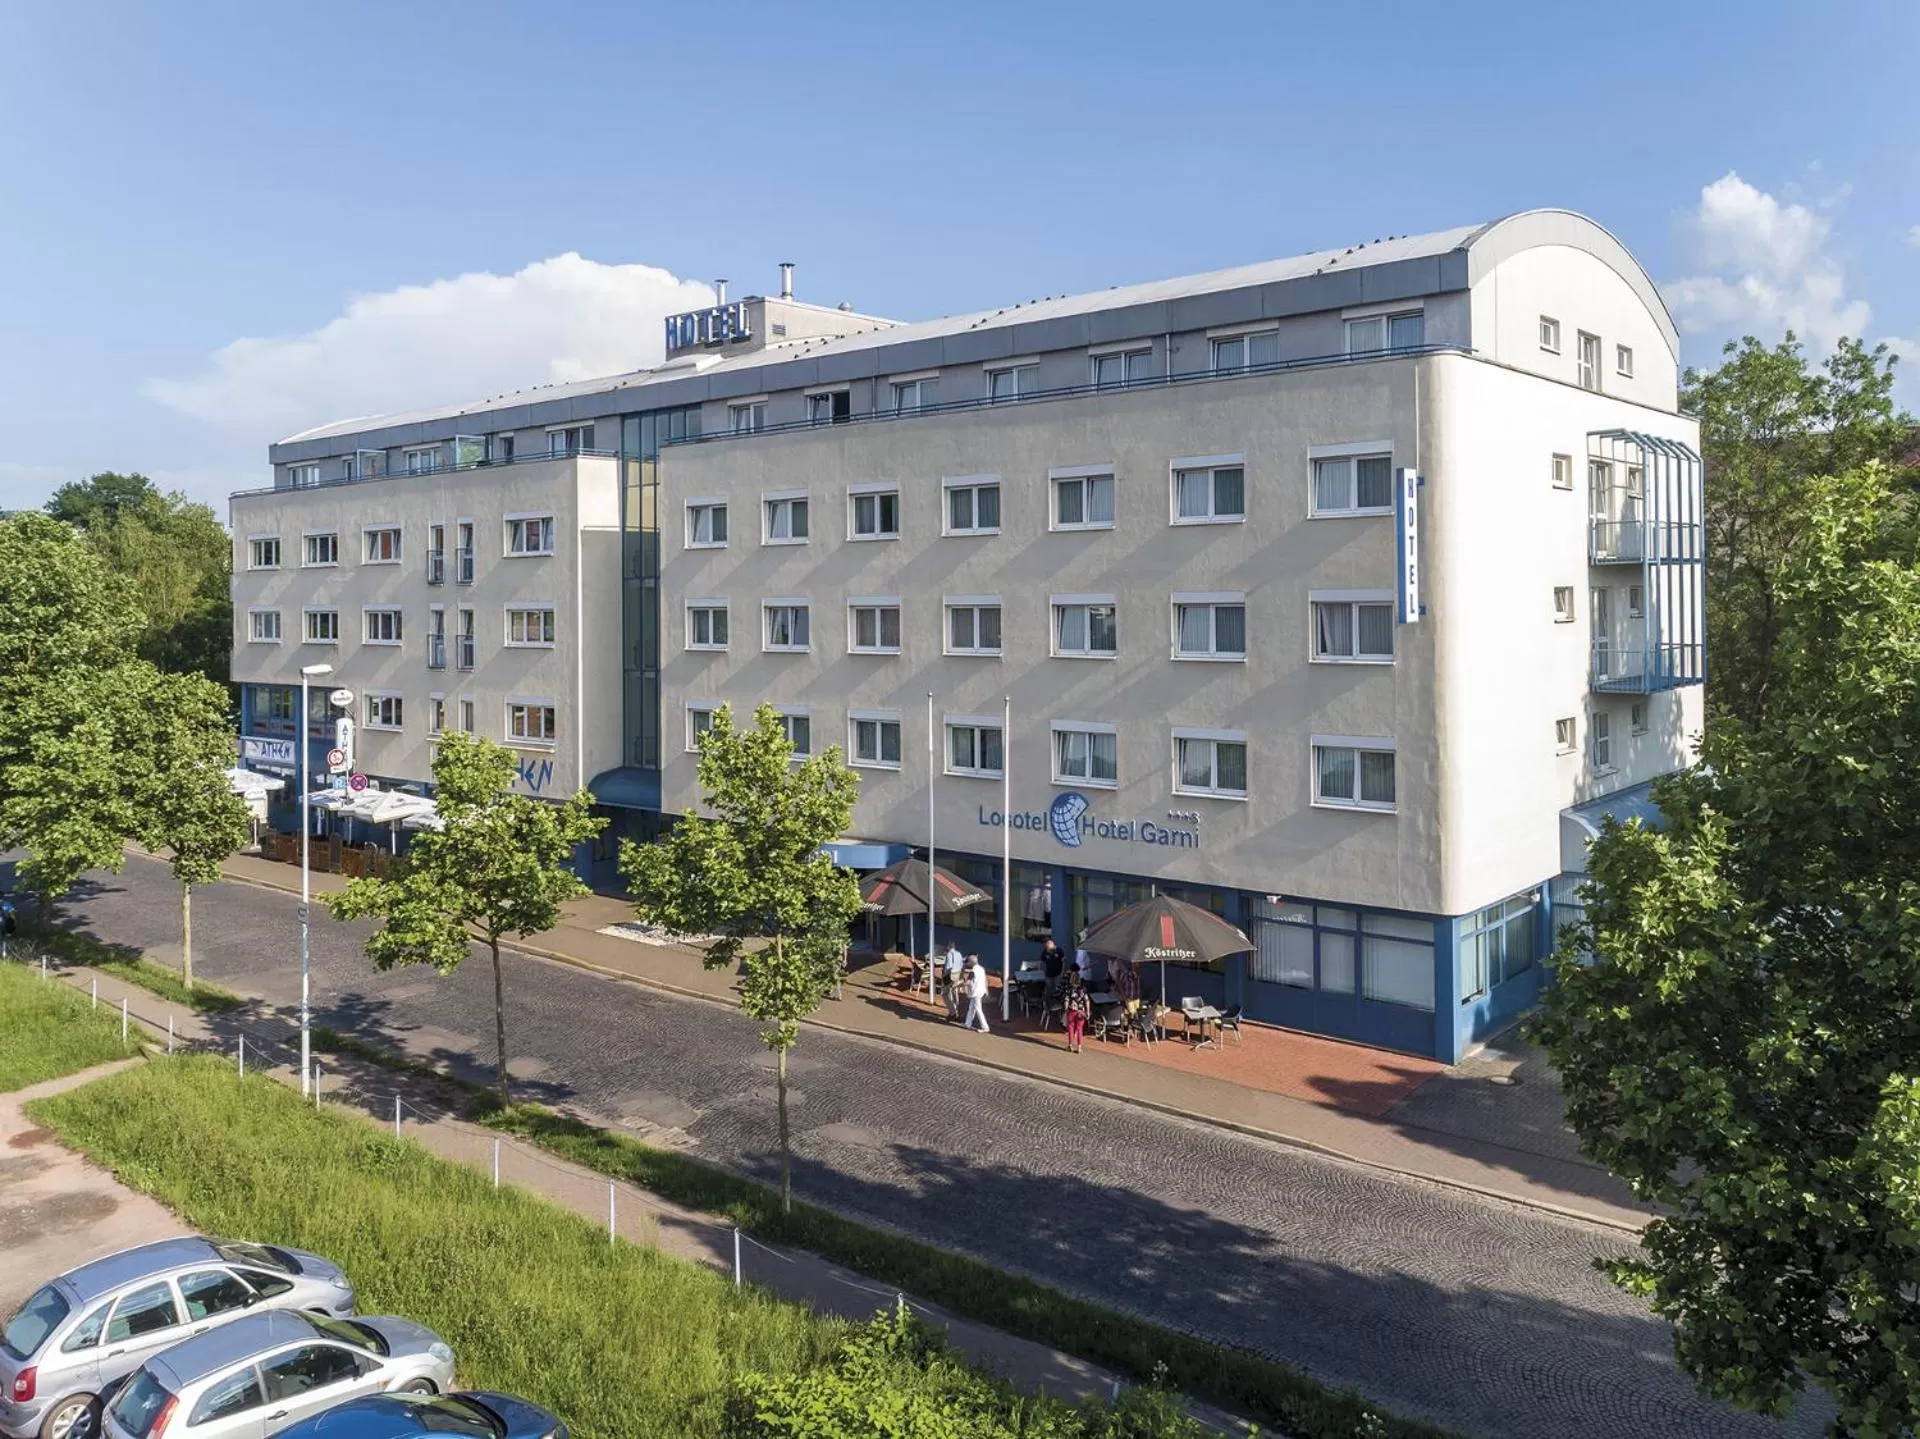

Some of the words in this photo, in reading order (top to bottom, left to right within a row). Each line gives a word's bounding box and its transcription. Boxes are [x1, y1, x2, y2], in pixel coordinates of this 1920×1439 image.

[665, 303, 749, 349] HOTEL
[261, 740, 290, 759] ATHEN
[1082, 815, 1135, 841] Hotel
[1141, 820, 1199, 848] Garni
